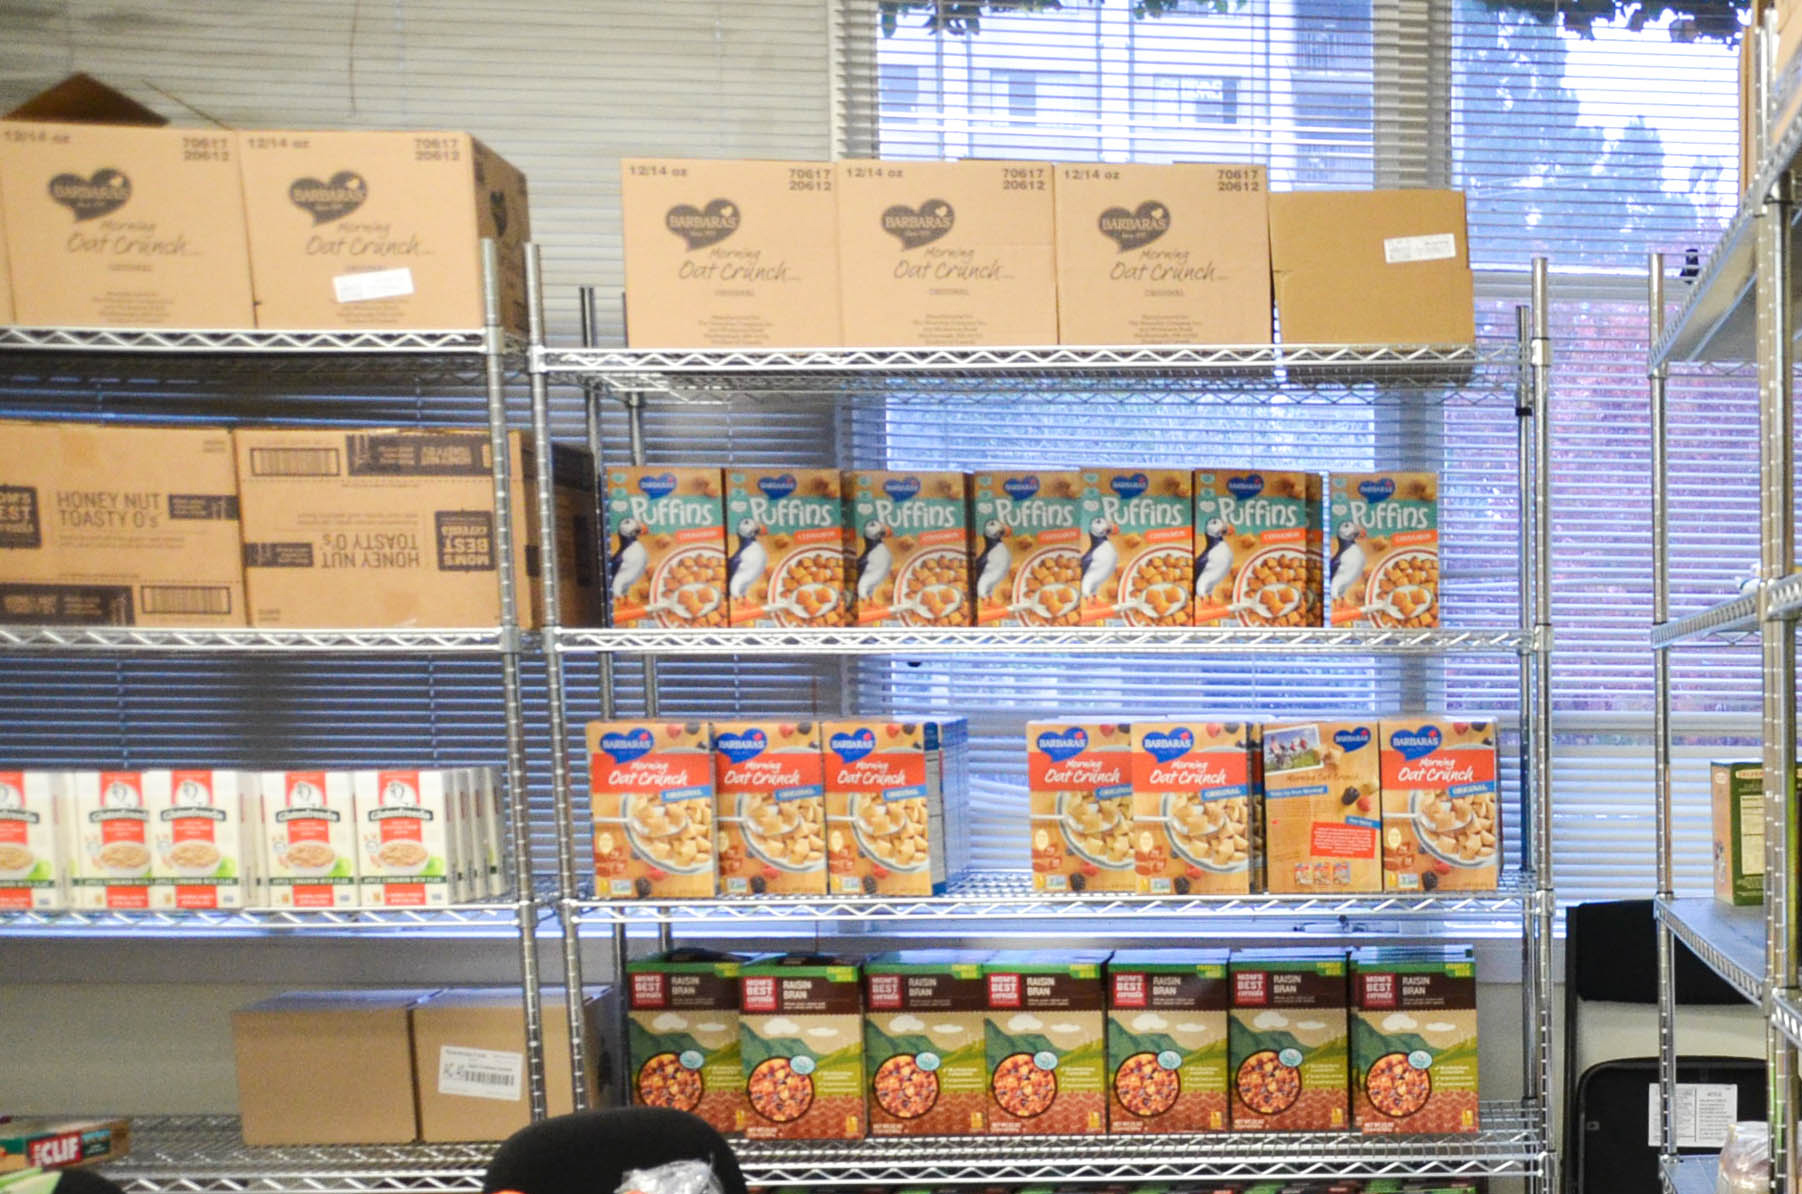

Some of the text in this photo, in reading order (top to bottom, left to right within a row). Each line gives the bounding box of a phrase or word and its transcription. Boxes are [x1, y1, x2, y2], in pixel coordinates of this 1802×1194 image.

[630, 165, 688, 177] 12/14 oz
[788, 168, 832, 179] 70617
[846, 168, 904, 178] 12/14 oz
[1002, 168, 1044, 179] 70617
[1064, 170, 1120, 181] 12/14 oz
[1217, 169, 1259, 180] 70617
[788, 181, 832, 191] 20612
[1002, 180, 1046, 191] 20612
[1217, 181, 1260, 192] 20612
[1139, 248, 1190, 264] Morning
[678, 260, 789, 282] Oat Crunch
[893, 259, 1002, 281] Oat Crunch
[1109, 260, 1217, 283] Oat Crunch
[56, 491, 119, 510] HONEY
[124, 491, 162, 511] NUT
[630, 496, 714, 529] Puffins
[750, 496, 833, 529] Puffins
[876, 500, 957, 530] Puffins
[995, 499, 1076, 529] Puffins
[1102, 497, 1184, 528] Puffins
[1217, 497, 1299, 528] Puffins
[1349, 500, 1430, 530] Puffins
[58, 509, 127, 529] TOASTY
[354, 532, 418, 551] TOASTY
[442, 538, 490, 553] BEST
[321, 550, 357, 568] NUT
[362, 550, 421, 569] HONEY
[608, 771, 689, 787] Oat Crunch
[724, 771, 801, 787] Oat Crunch
[836, 771, 907, 786] Oat Crunch
[1044, 767, 1121, 785] Oat Crunch
[1150, 767, 1228, 785] Oat Crunch
[1397, 766, 1475, 784] Oat Crunch
[671, 976, 700, 986] RAISIN
[782, 980, 813, 990] RAISIN
[908, 977, 937, 987] RAISIN
[1026, 977, 1055, 987] RAISIN
[1152, 976, 1182, 986] RAISIN
[1273, 974, 1302, 985] RAISIN
[1402, 975, 1431, 986] RAISIN
[635, 983, 661, 993] BEST
[671, 986, 696, 996] BRAN
[746, 986, 774, 997] BEST
[871, 985, 899, 994] BEST
[908, 987, 933, 997] BRAN
[990, 983, 1018, 993] BEST
[1026, 987, 1051, 997] BRAN
[1116, 982, 1143, 991] BEST
[1152, 986, 1177, 996] BRAN
[1237, 982, 1265, 991] BEST
[1273, 984, 1297, 995] BRAN
[1365, 983, 1393, 992] BEST
[1402, 986, 1427, 996] BRAN
[783, 990, 808, 1000] BRAN
[41, 1136, 80, 1166] CLIF
